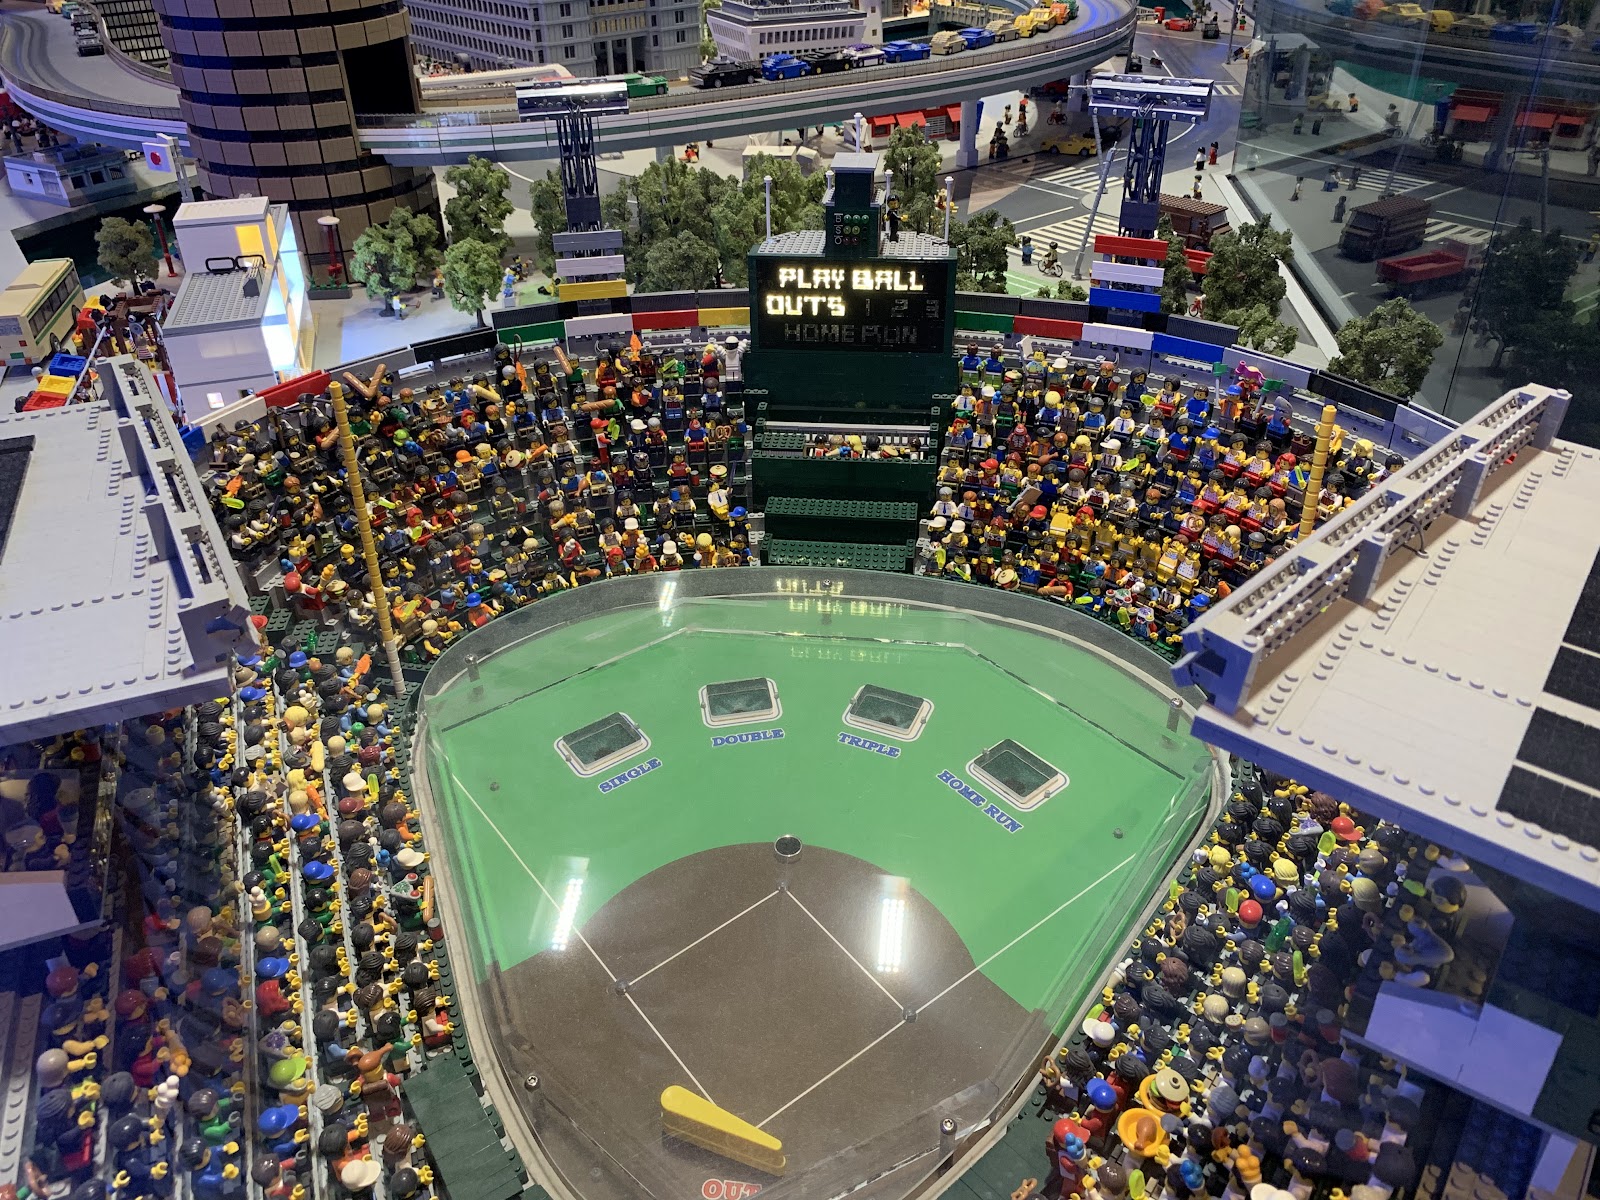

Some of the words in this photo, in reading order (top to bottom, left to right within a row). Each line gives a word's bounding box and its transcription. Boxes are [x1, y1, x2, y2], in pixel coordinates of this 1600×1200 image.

[778, 268, 846, 290] PLAY
[852, 269, 924, 291] BALL
[766, 295, 846, 317] OUTS
[784, 323, 855, 343] HOME
[711, 728, 785, 747] DOUBLE
[838, 732, 901, 758] TRIPLE
[598, 757, 662, 794] SINGLE
[936, 769, 987, 807] HOME
[981, 803, 1024, 834] RUN
